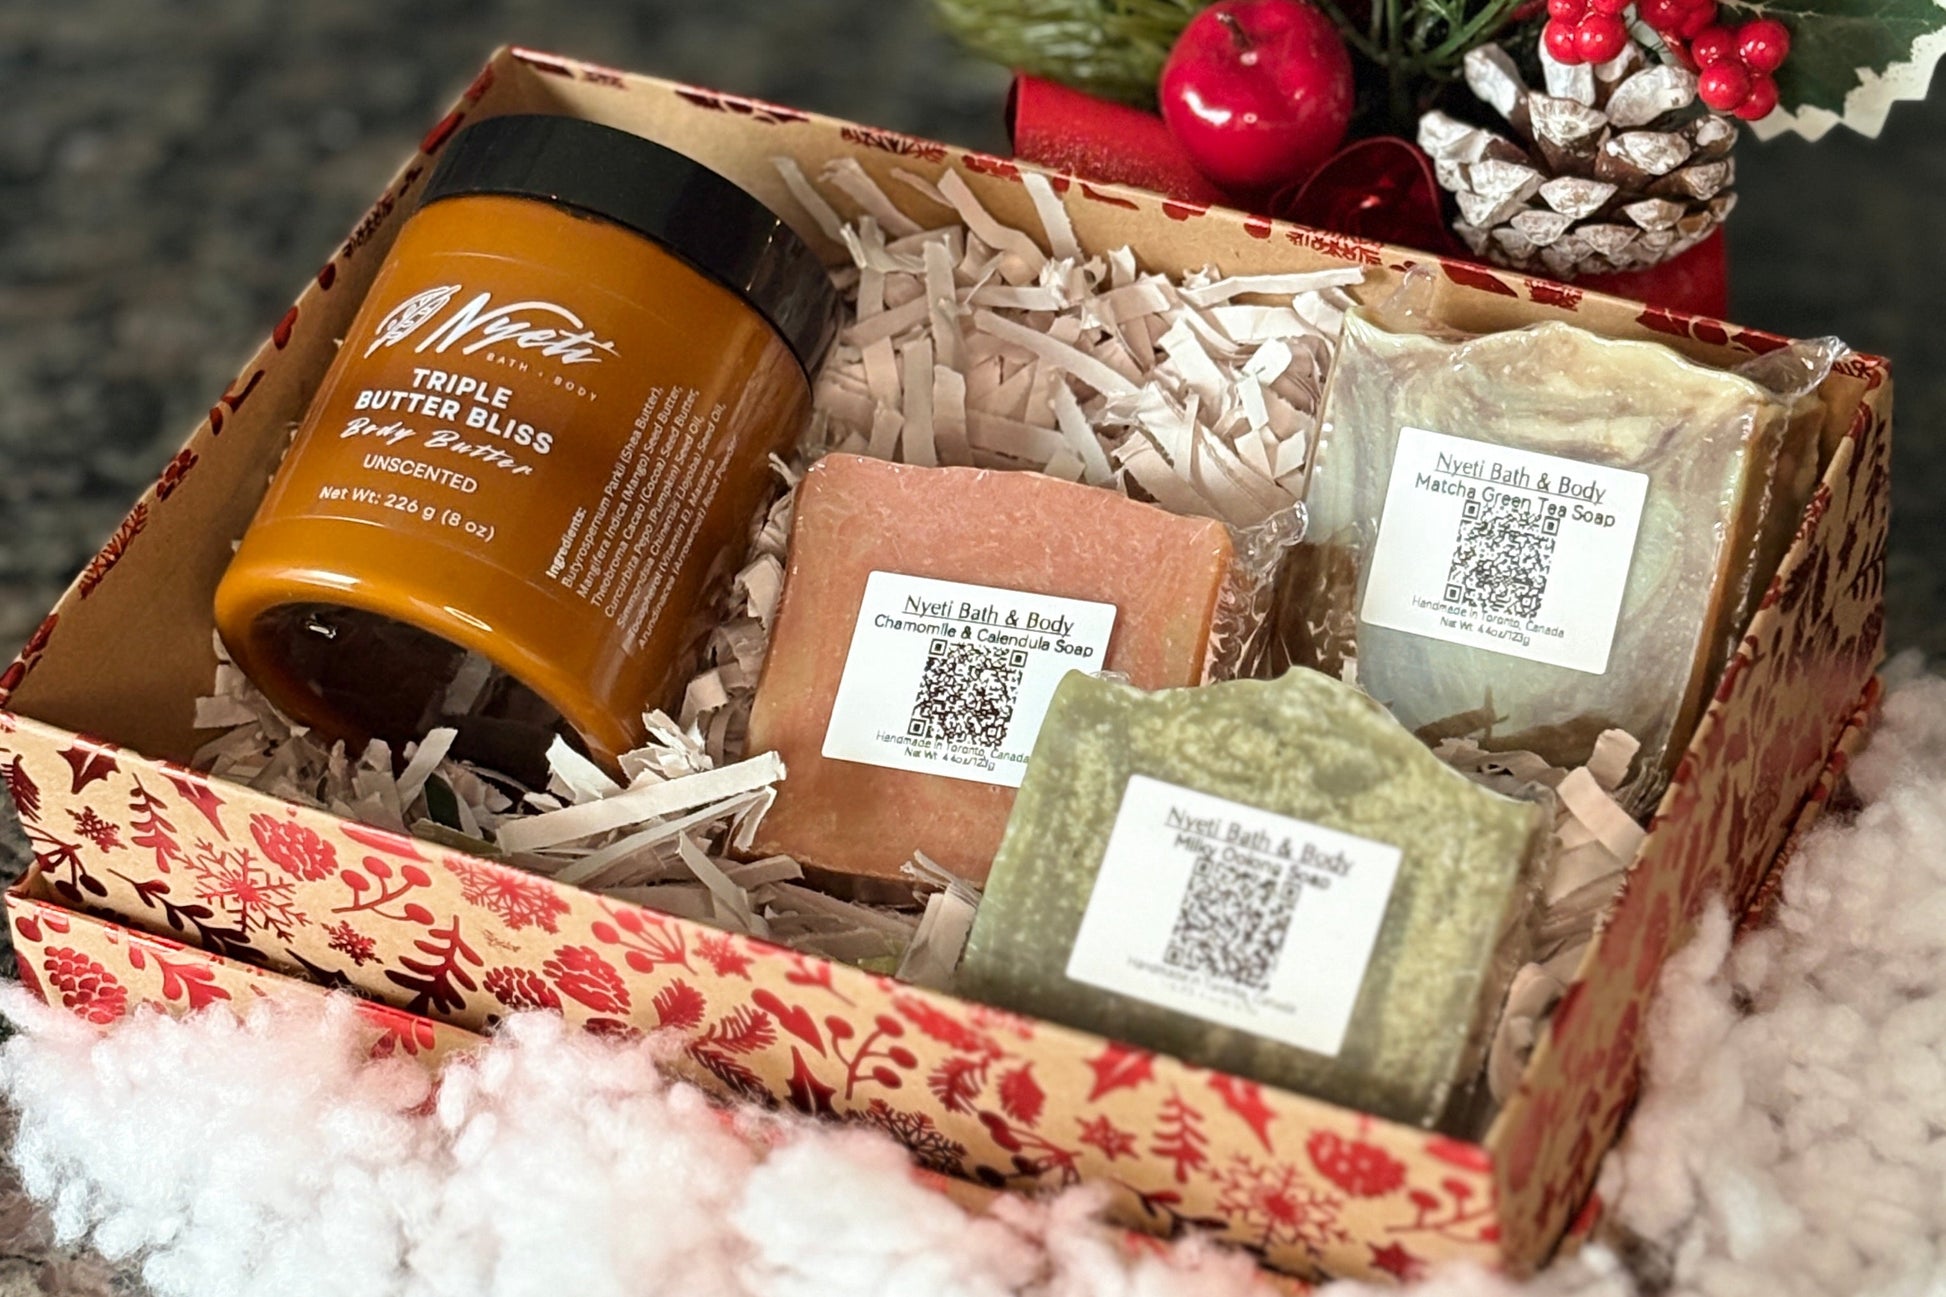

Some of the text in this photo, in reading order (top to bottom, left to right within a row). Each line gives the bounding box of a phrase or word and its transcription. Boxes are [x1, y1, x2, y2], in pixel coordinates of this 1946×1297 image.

[415, 292, 621, 364] Nyeti
[412, 368, 513, 409] TRIPLE
[486, 352, 597, 401] BATH BODY
[340, 417, 533, 475] Body Butter
[354, 390, 554, 454] BUTTER BLISS
[619, 430, 642, 463] (Shea
[697, 420, 715, 452] Seed
[363, 453, 478, 493] UNSCENTED
[633, 523, 653, 555] Pepo
[648, 464, 680, 524] (Pumpkin)
[674, 433, 694, 465] Seed
[1415, 472, 1616, 528] Matcha Green Tea Soap
[1436, 451, 1606, 505] Nyeti Bath & Body
[319, 486, 495, 543] Net Wt: 226 g (8 oz)
[576, 538, 611, 599] Mangifera
[604, 501, 628, 539] Indica
[621, 452, 650, 502] (Mango)
[643, 421, 663, 454] Seed
[590, 540, 628, 607] Theobroma
[622, 503, 645, 540] Cacao
[639, 456, 666, 503] (Cocoa)
[660, 425, 680, 458] Seed
[545, 507, 587, 579] Ingredients:
[874, 614, 1094, 658] Chamomile & Calendula Soap
[905, 594, 1074, 638] Nyeti Bath & Body
[1412, 595, 1467, 617] Handmade
[1470, 610, 1478, 619] in
[1525, 620, 1565, 638] Canada
[876, 730, 931, 748] Handmade
[933, 741, 942, 750] in
[990, 749, 1030, 764] Canada
[1165, 806, 1355, 877] Nyeti Bath & Body
